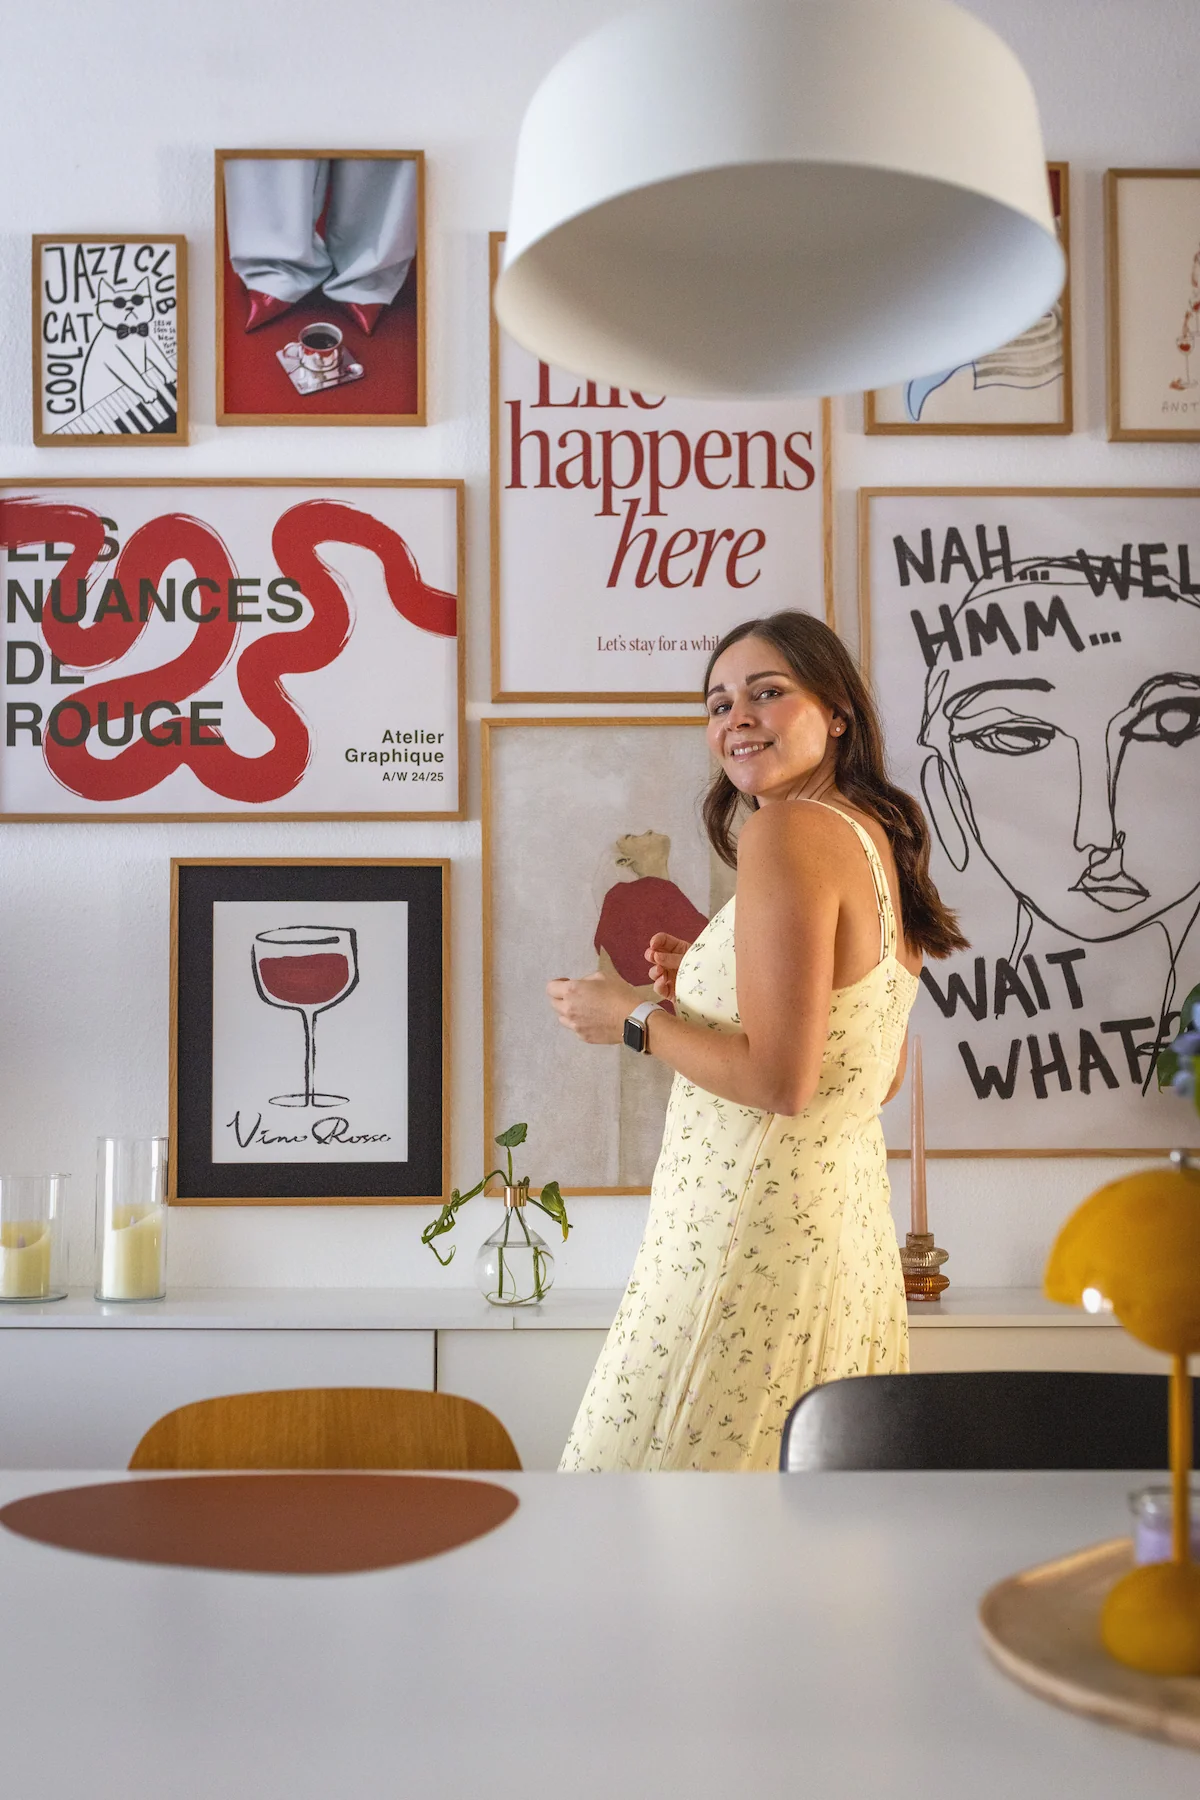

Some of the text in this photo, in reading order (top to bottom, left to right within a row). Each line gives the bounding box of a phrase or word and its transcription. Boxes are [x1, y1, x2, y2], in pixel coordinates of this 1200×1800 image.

[44, 243, 177, 315] JAZZ CLUB
[43, 311, 93, 344] CAT
[45, 347, 83, 415] COOL
[504, 399, 816, 517] happens
[606, 497, 766, 588] here
[893, 524, 1050, 586] NAH...
[6, 577, 303, 623] NUANCES
[629, 638, 655, 655] stay
[658, 635, 677, 651] for
[680, 640, 688, 651] a
[910, 595, 1122, 667] HMM...
[5, 701, 224, 747] ROUGE
[381, 729, 444, 744] Atelier
[345, 748, 444, 766] Graphique
[382, 772, 444, 781] A/W 24/25
[920, 948, 1086, 1021] WAIT
[226, 1111, 391, 1148] Vino Rosso
